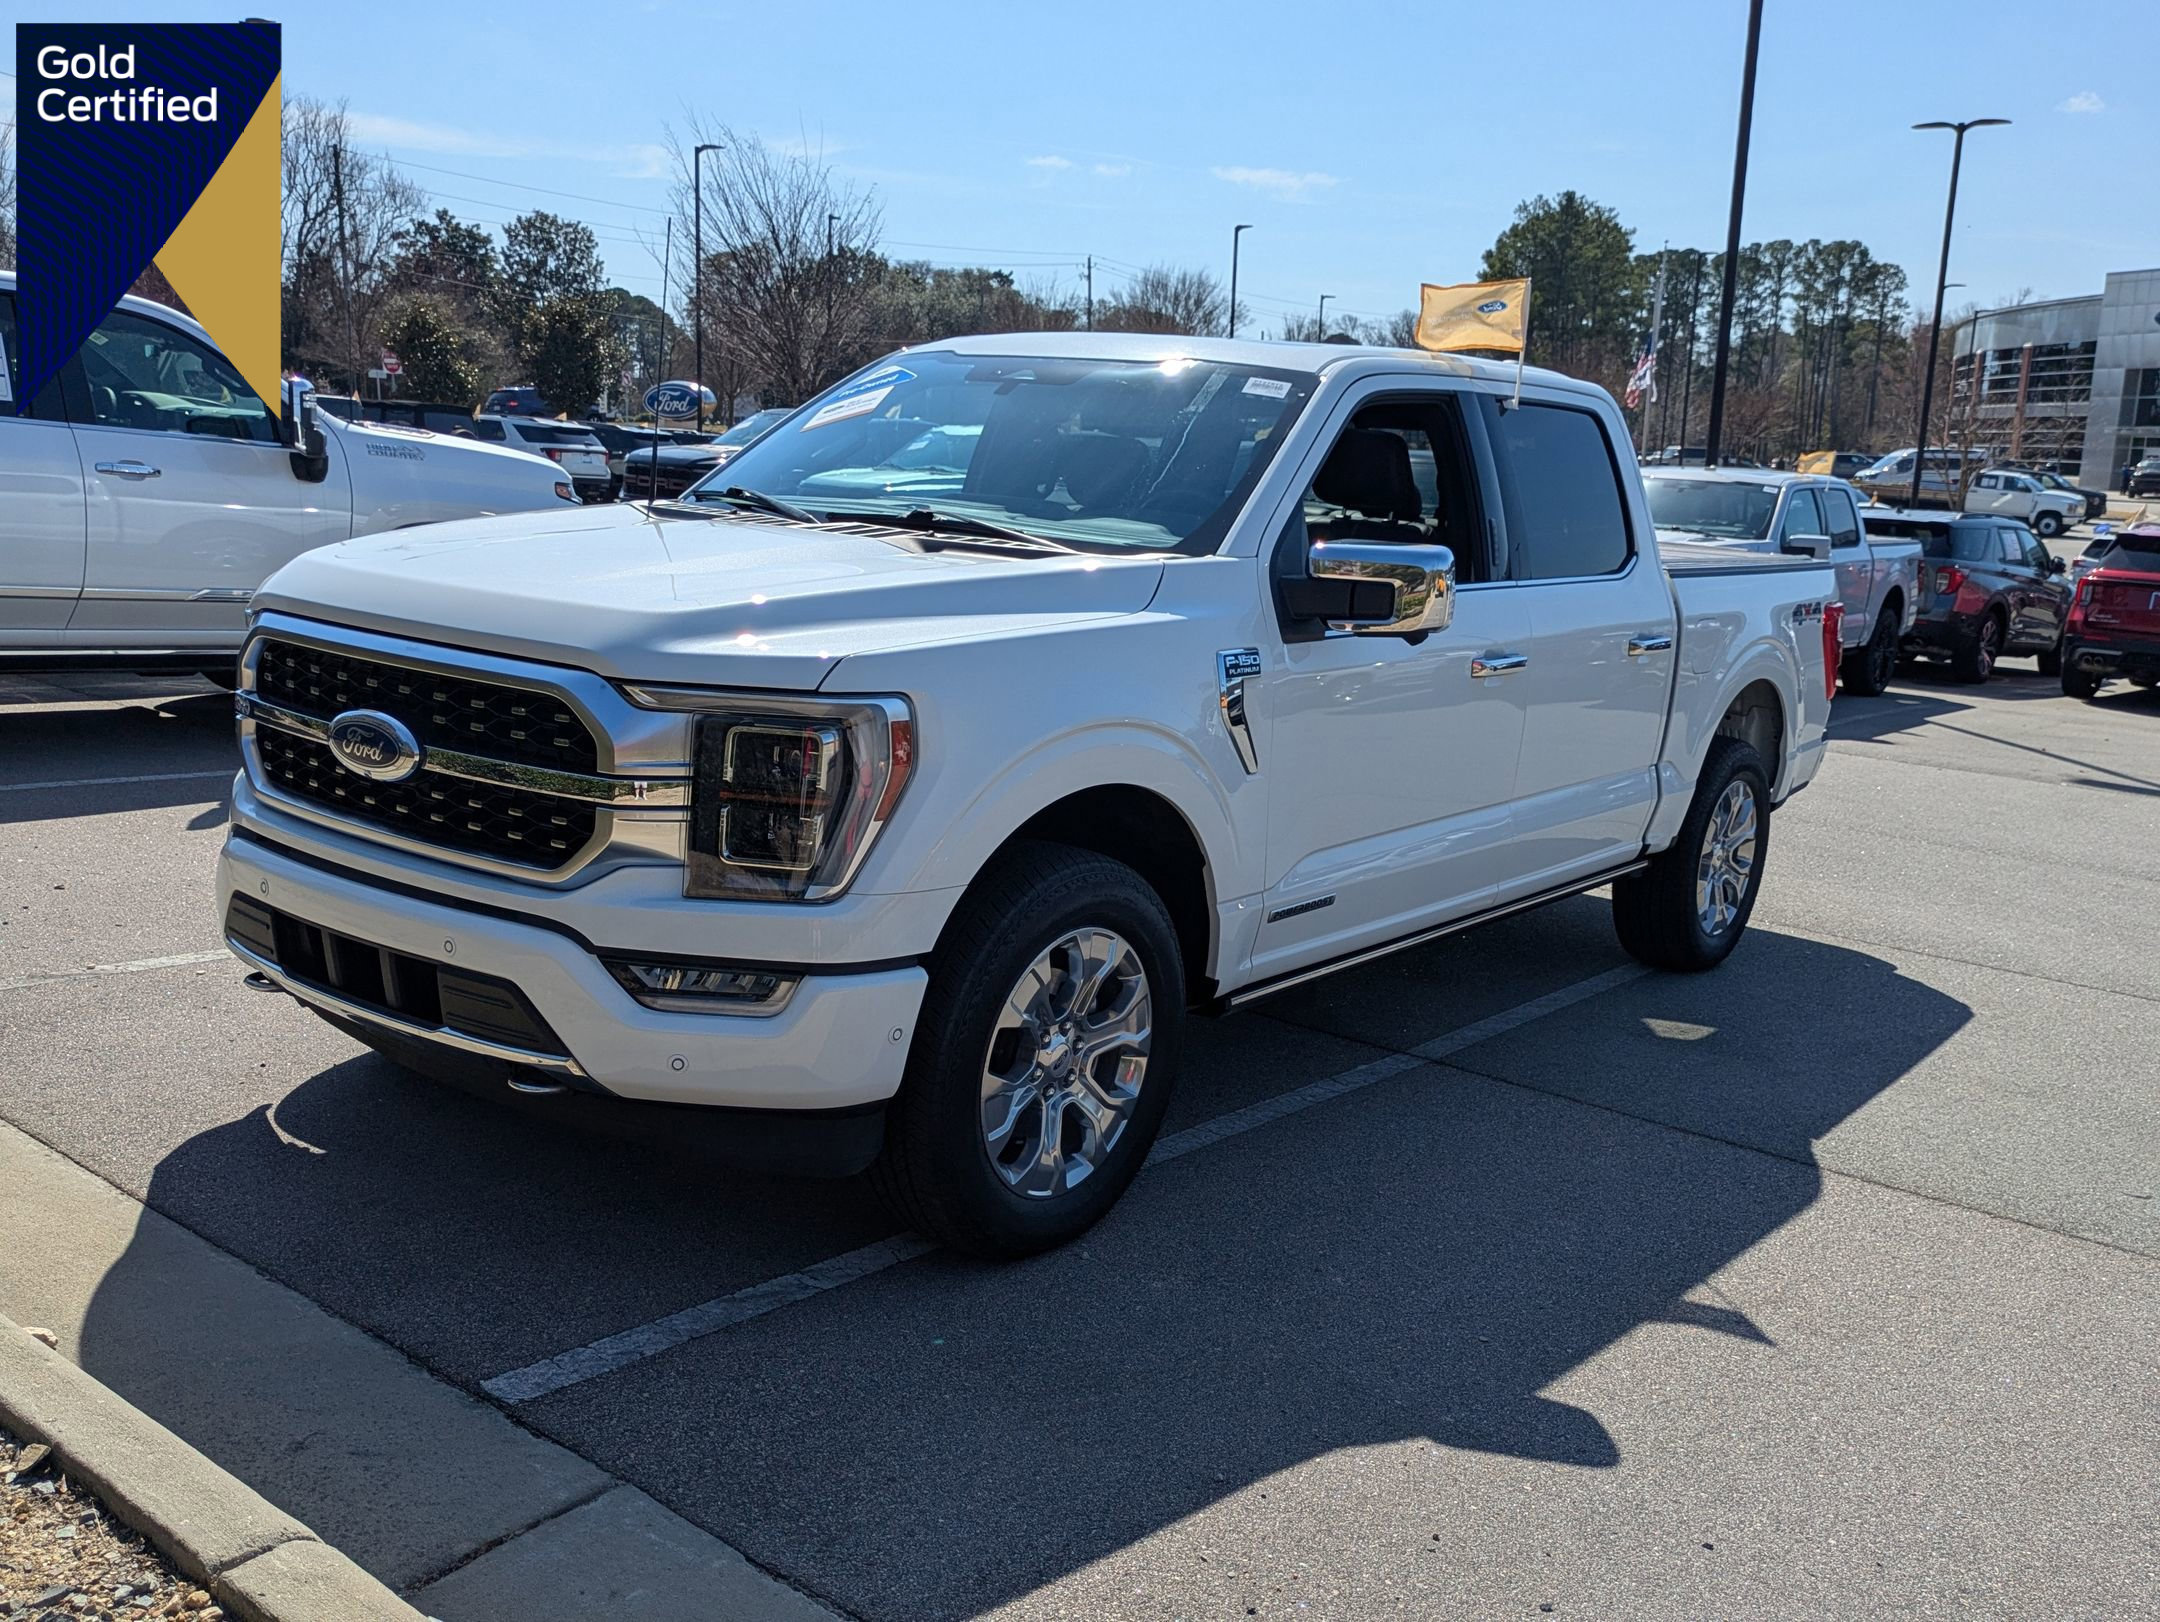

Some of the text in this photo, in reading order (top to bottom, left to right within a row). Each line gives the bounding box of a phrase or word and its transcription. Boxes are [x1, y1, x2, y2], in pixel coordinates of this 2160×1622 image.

[655, 390, 690, 412] Ford
[1225, 654, 1260, 667] F-150
[1229, 665, 1260, 675] PLATINUM
[342, 726, 385, 761] Ford
